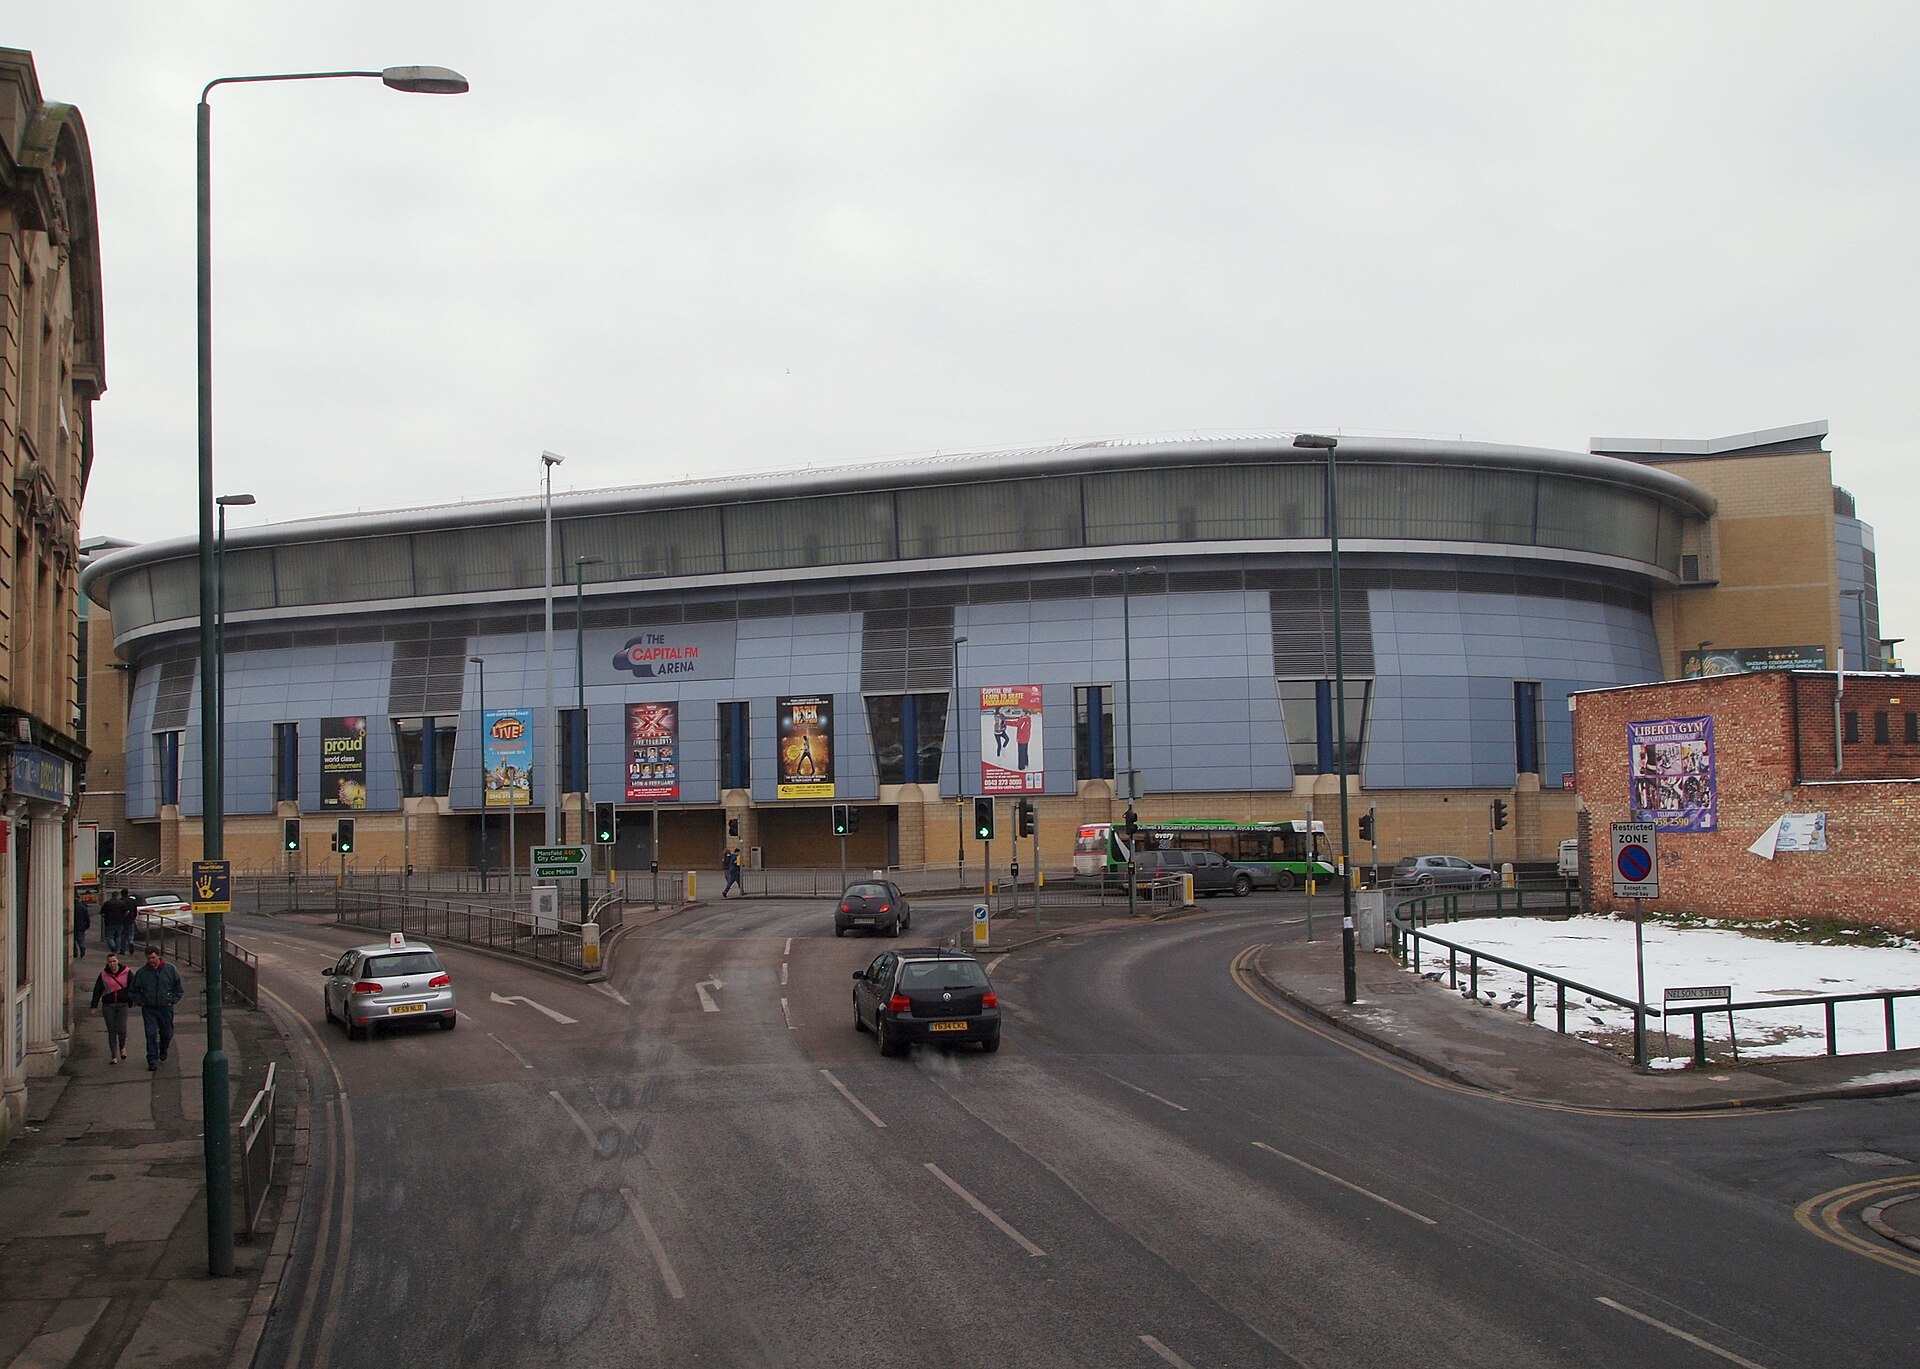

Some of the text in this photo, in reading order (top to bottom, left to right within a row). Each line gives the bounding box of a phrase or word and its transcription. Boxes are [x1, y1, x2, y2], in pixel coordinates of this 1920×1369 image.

[646, 634, 665, 644] THE
[631, 647, 698, 661] CAPITAL FM
[657, 661, 695, 675] ARENA
[1634, 721, 1703, 736] LIBERTY GYM
[324, 736, 363, 755] proud
[1669, 817, 1689, 826] 2590
[1612, 823, 1653, 832] Restricted
[1619, 834, 1648, 843] ZONE
[1666, 988, 1728, 999] NELSON STREET
